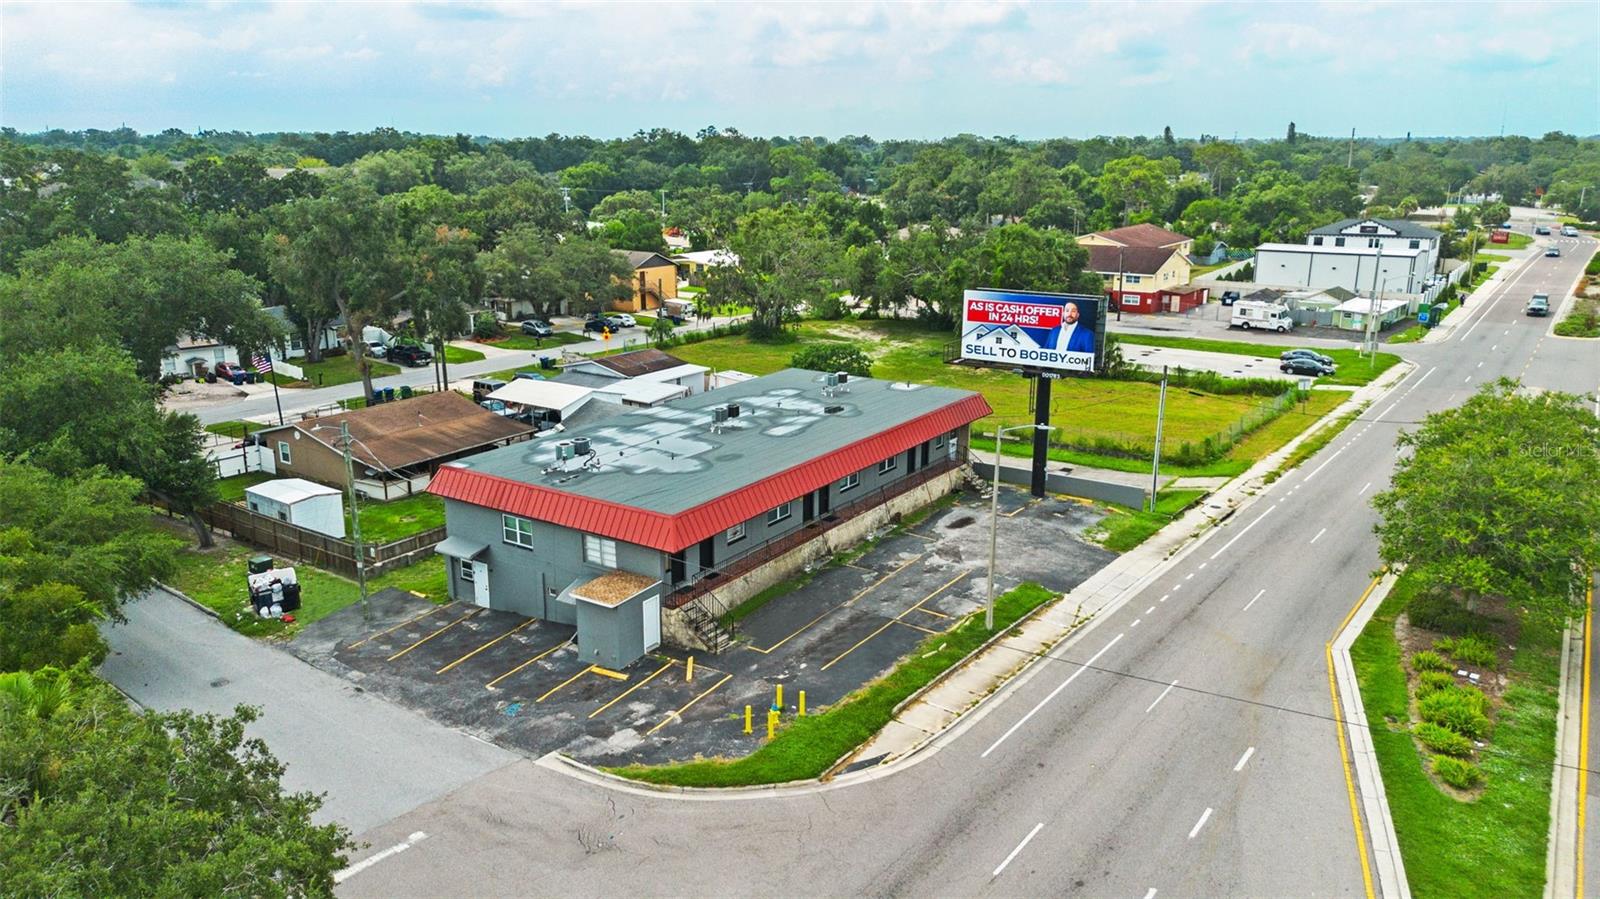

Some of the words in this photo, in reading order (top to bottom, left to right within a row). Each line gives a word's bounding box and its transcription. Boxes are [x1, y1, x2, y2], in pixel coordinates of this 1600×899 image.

[970, 302, 983, 311] AS
[985, 303, 994, 311] IS
[996, 304, 1023, 313] CASH
[1025, 306, 1060, 317] OFFER
[1001, 313, 1013, 321] 24
[1015, 315, 1039, 324] HRS!
[966, 344, 997, 356] SELL
[1000, 347, 1016, 358] TO
